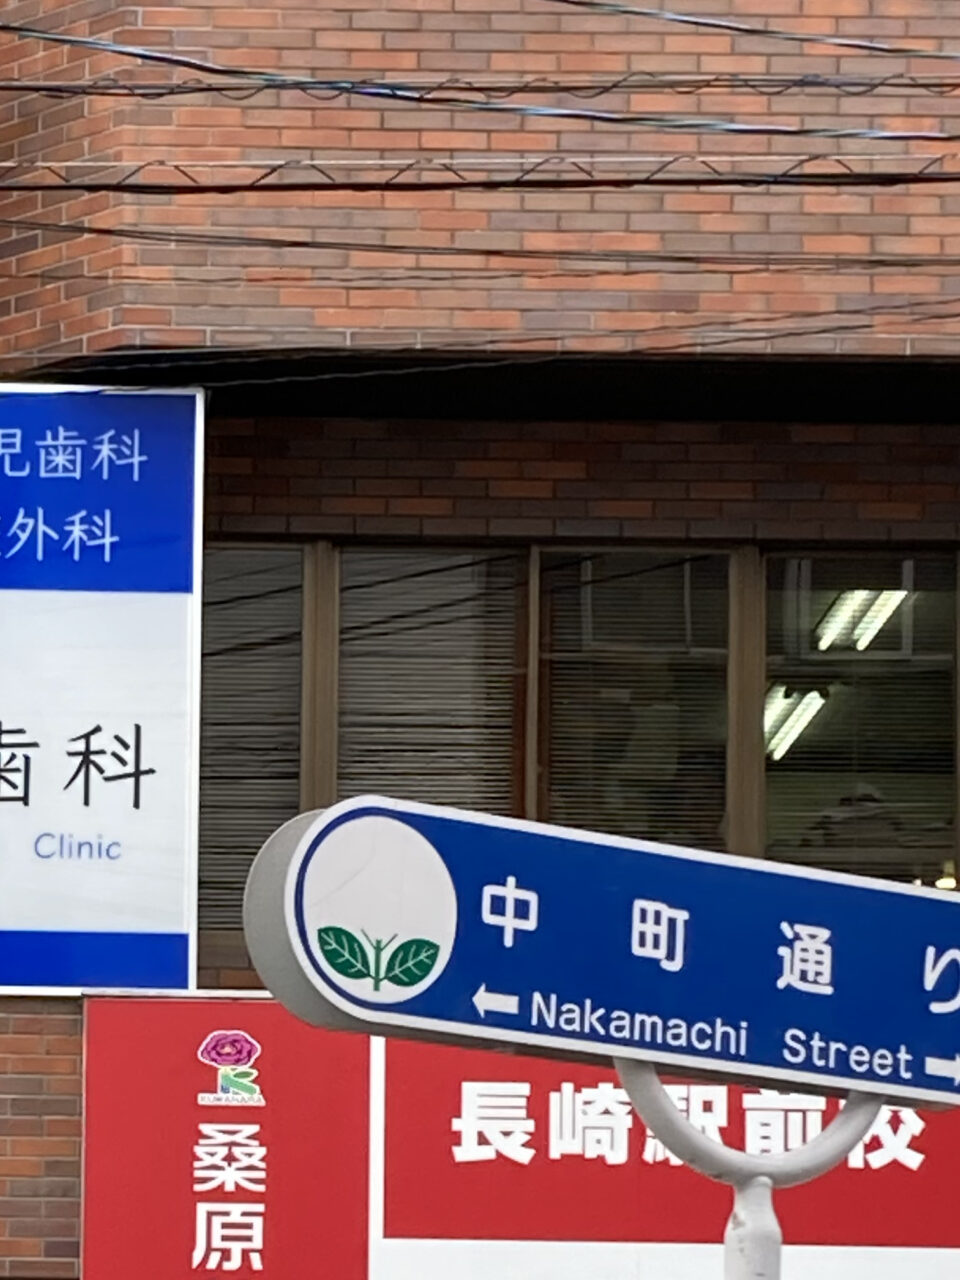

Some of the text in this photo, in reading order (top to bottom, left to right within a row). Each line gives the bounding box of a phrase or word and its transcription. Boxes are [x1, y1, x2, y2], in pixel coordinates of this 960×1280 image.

[33, 832, 122, 861] Clinic
[481, 875, 960, 1014] 中町通り
[530, 991, 914, 1080] Nakamachi Street
